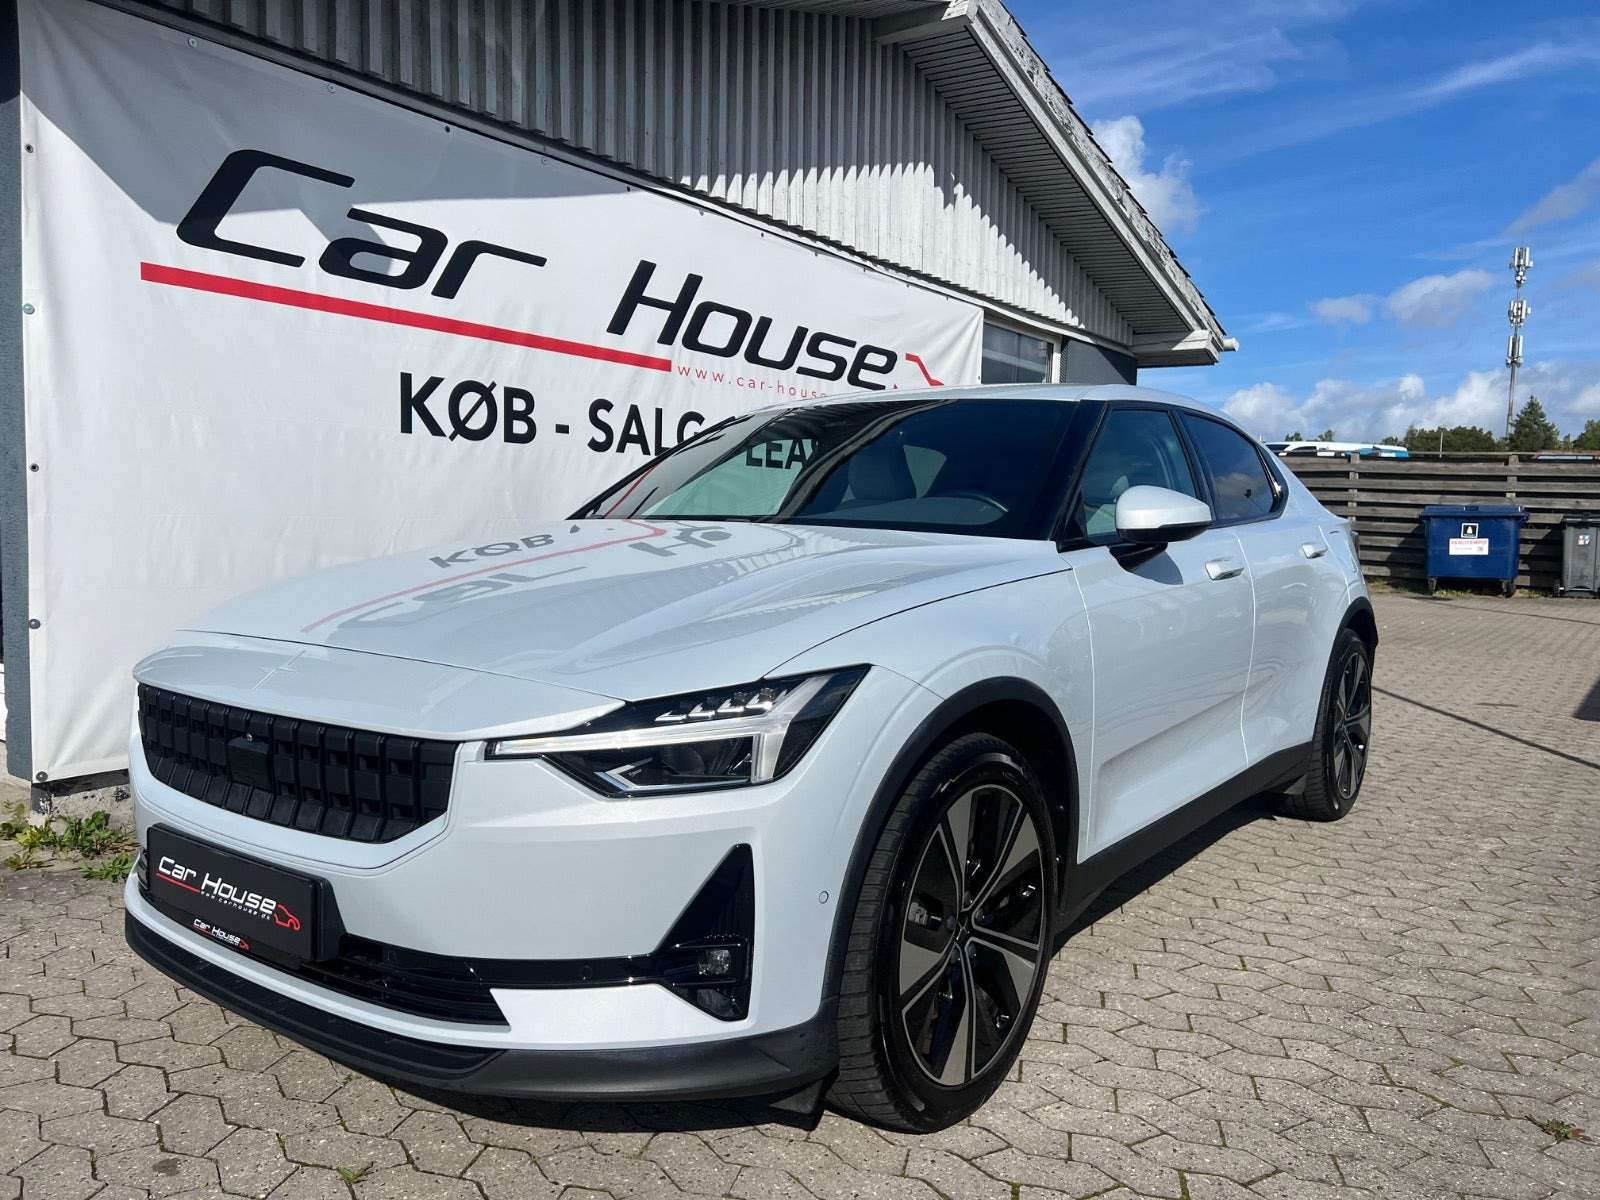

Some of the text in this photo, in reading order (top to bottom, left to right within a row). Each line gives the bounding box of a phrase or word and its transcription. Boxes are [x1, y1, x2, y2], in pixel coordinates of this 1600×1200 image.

[176, 149, 898, 390] Car House
[400, 372, 537, 443] KØB
[746, 439, 818, 469] LEA
[158, 856, 277, 914] Car House
[193, 918, 211, 929] Car
[211, 925, 241, 944] House
